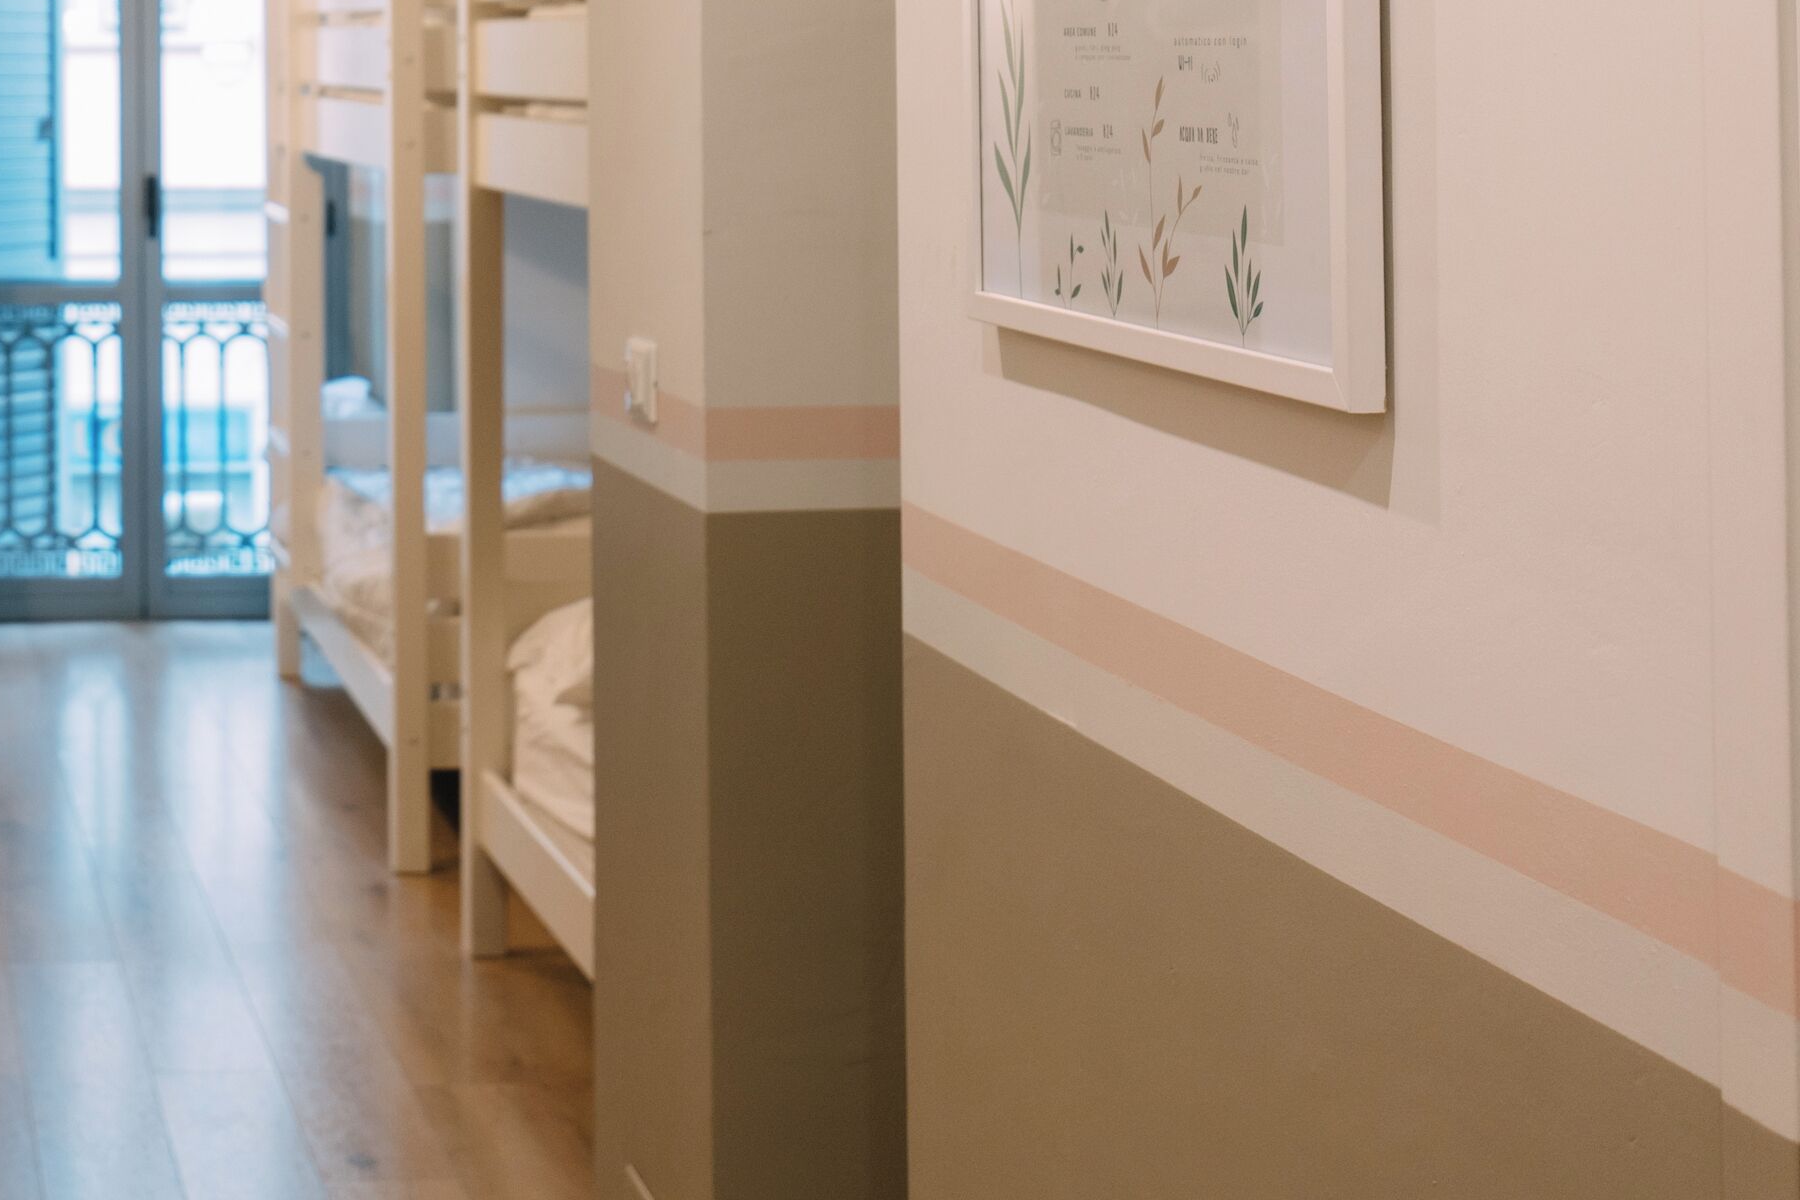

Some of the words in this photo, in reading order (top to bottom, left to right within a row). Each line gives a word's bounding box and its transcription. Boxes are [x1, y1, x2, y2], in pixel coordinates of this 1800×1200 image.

[1064, 88, 1081, 99] CUCINA
[1064, 126, 1094, 137] LAVANDERIA
[1179, 125, 1195, 142] ACQUA
